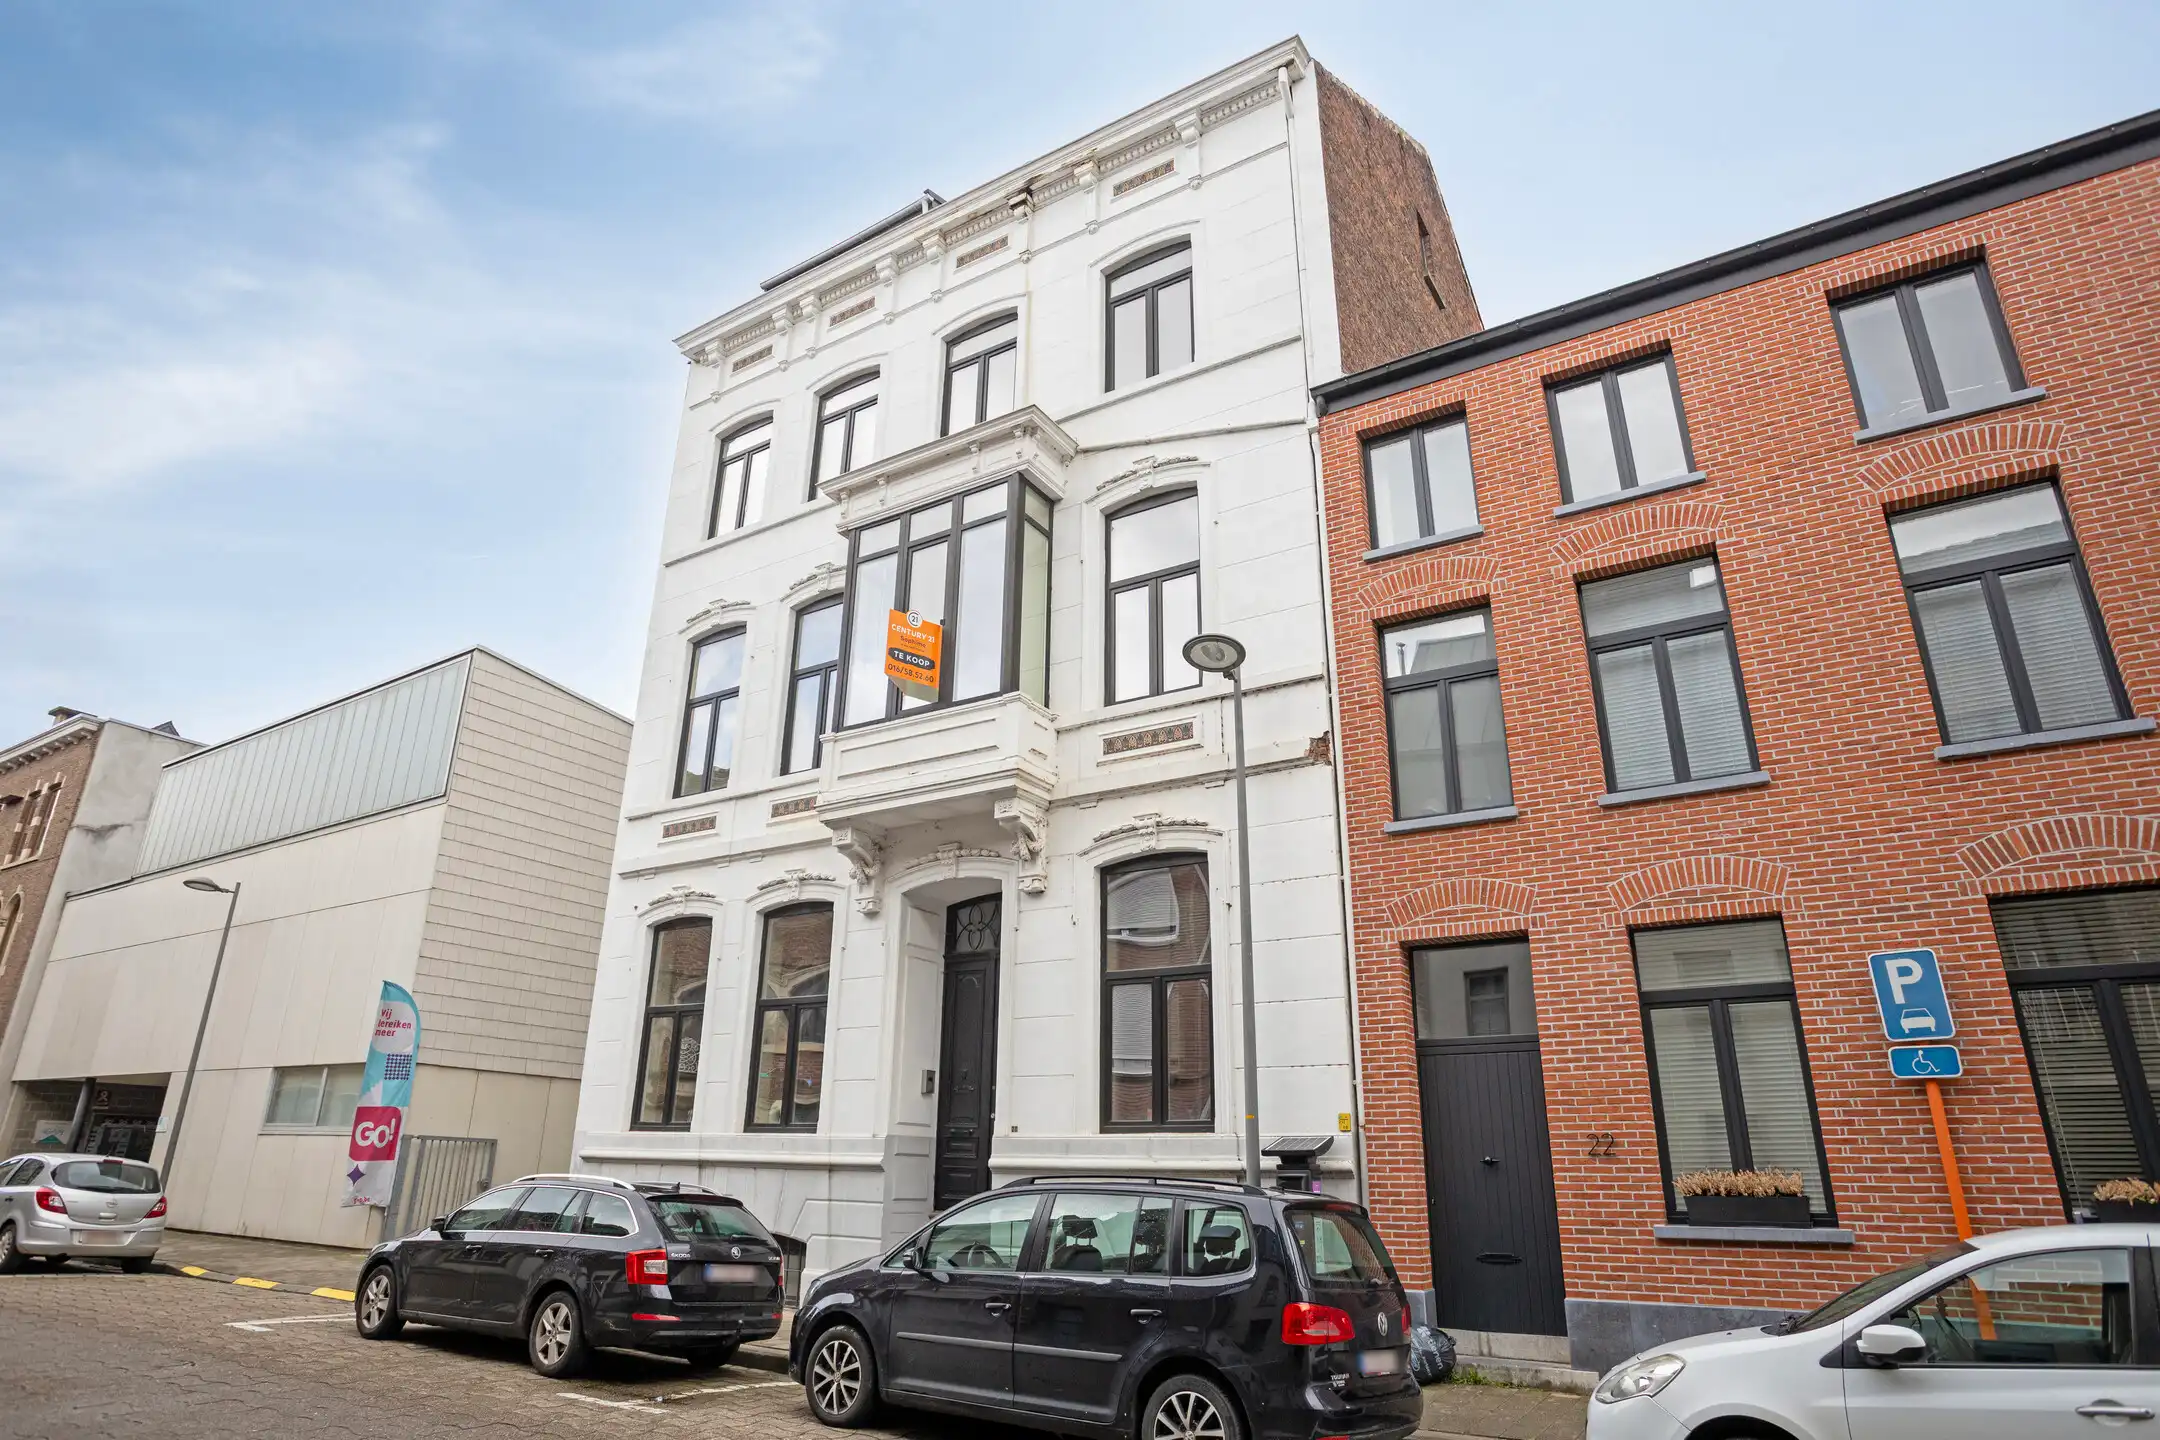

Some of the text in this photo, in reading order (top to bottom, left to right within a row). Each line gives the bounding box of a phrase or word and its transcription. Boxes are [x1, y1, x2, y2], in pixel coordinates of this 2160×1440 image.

[891, 623, 935, 643] CENTURY 21
[893, 650, 930, 667] TE KOOP
[888, 663, 934, 682] 016/58.52.60
[1885, 958, 1923, 1005] P
[355, 1118, 396, 1148] GO!
[1586, 1133, 1616, 1157] 22
